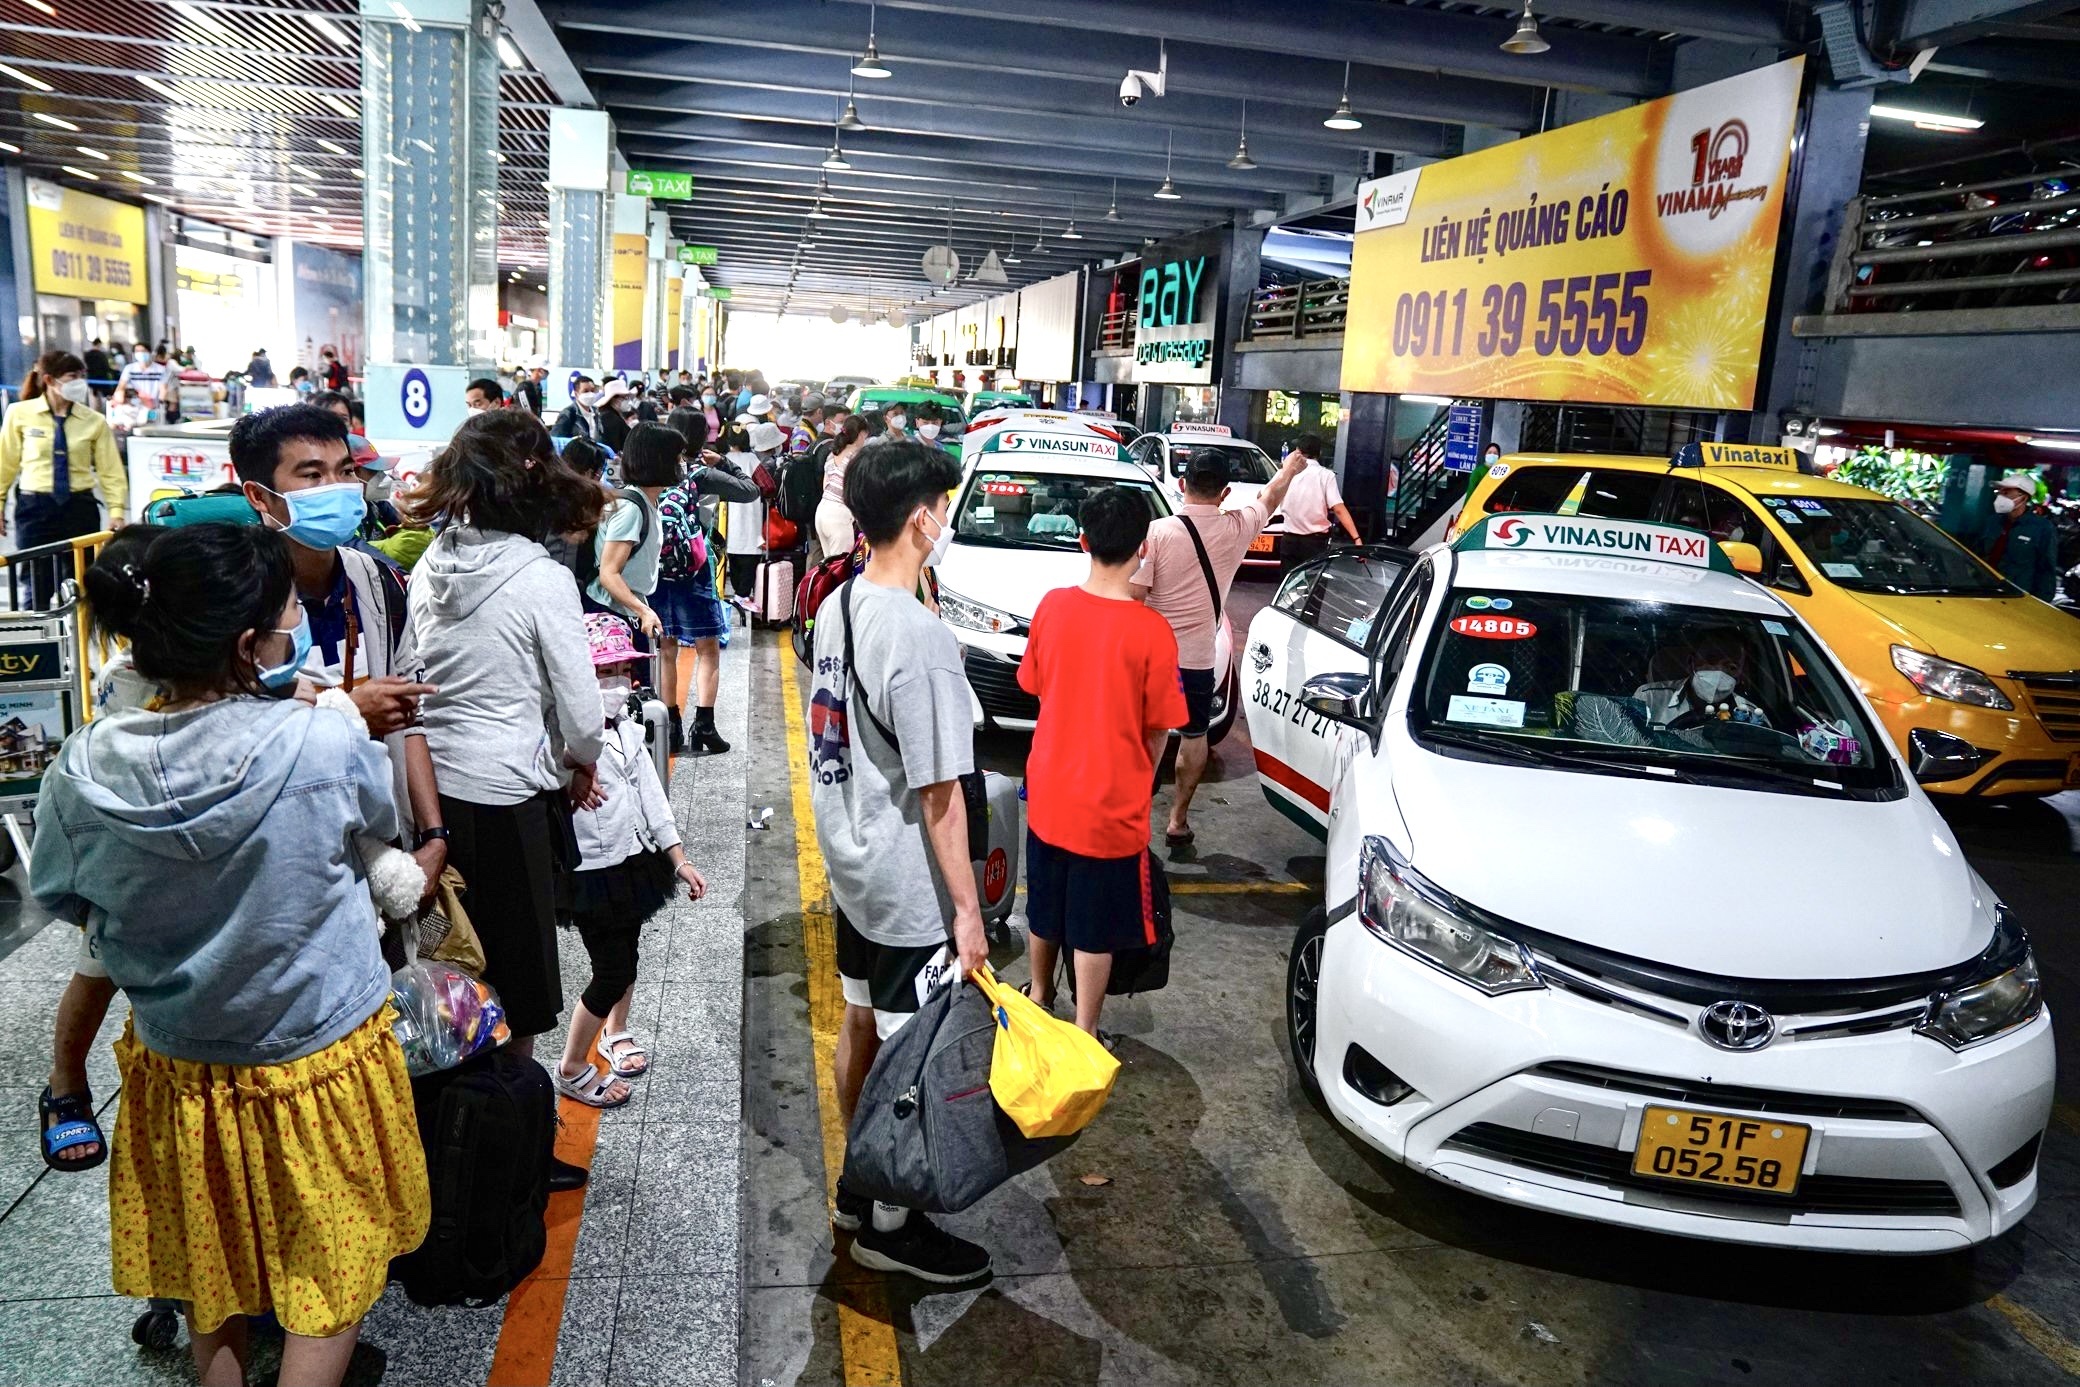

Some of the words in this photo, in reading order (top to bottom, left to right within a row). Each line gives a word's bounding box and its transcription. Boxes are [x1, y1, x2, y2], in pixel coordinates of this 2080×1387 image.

[656, 179, 690, 193] TAXI
[1657, 183, 1727, 217] VINAMA
[1421, 216, 1462, 264] LIÊN
[1464, 208, 1491, 264] HỆ
[1494, 192, 1570, 257] QUẢNG
[1575, 183, 1629, 241] CÁO
[53, 249, 82, 279] 0911
[87, 254, 102, 282] 39
[105, 257, 131, 286] 5555
[696, 252, 716, 260] TAXI
[1393, 288, 1467, 357] 0911
[1478, 281, 1527, 357] 39
[1535, 269, 1652, 356] 5555
[405, 379, 428, 418] 8
[1491, 466, 1508, 476] 6019
[1710, 446, 1789, 465] Vinataxi
[1791, 499, 1821, 509] 6019
[1543, 525, 1650, 551] VINASUN
[1656, 534, 1706, 558] TAXI
[1458, 619, 1530, 635] 14805
[1252, 679, 1291, 717] 38.27
[1291, 699, 1310, 727] 27
[60, 1126, 88, 1139] SPORT
[1688, 1116, 1760, 1150] 51F
[1652, 1146, 1781, 1188] 052.58
